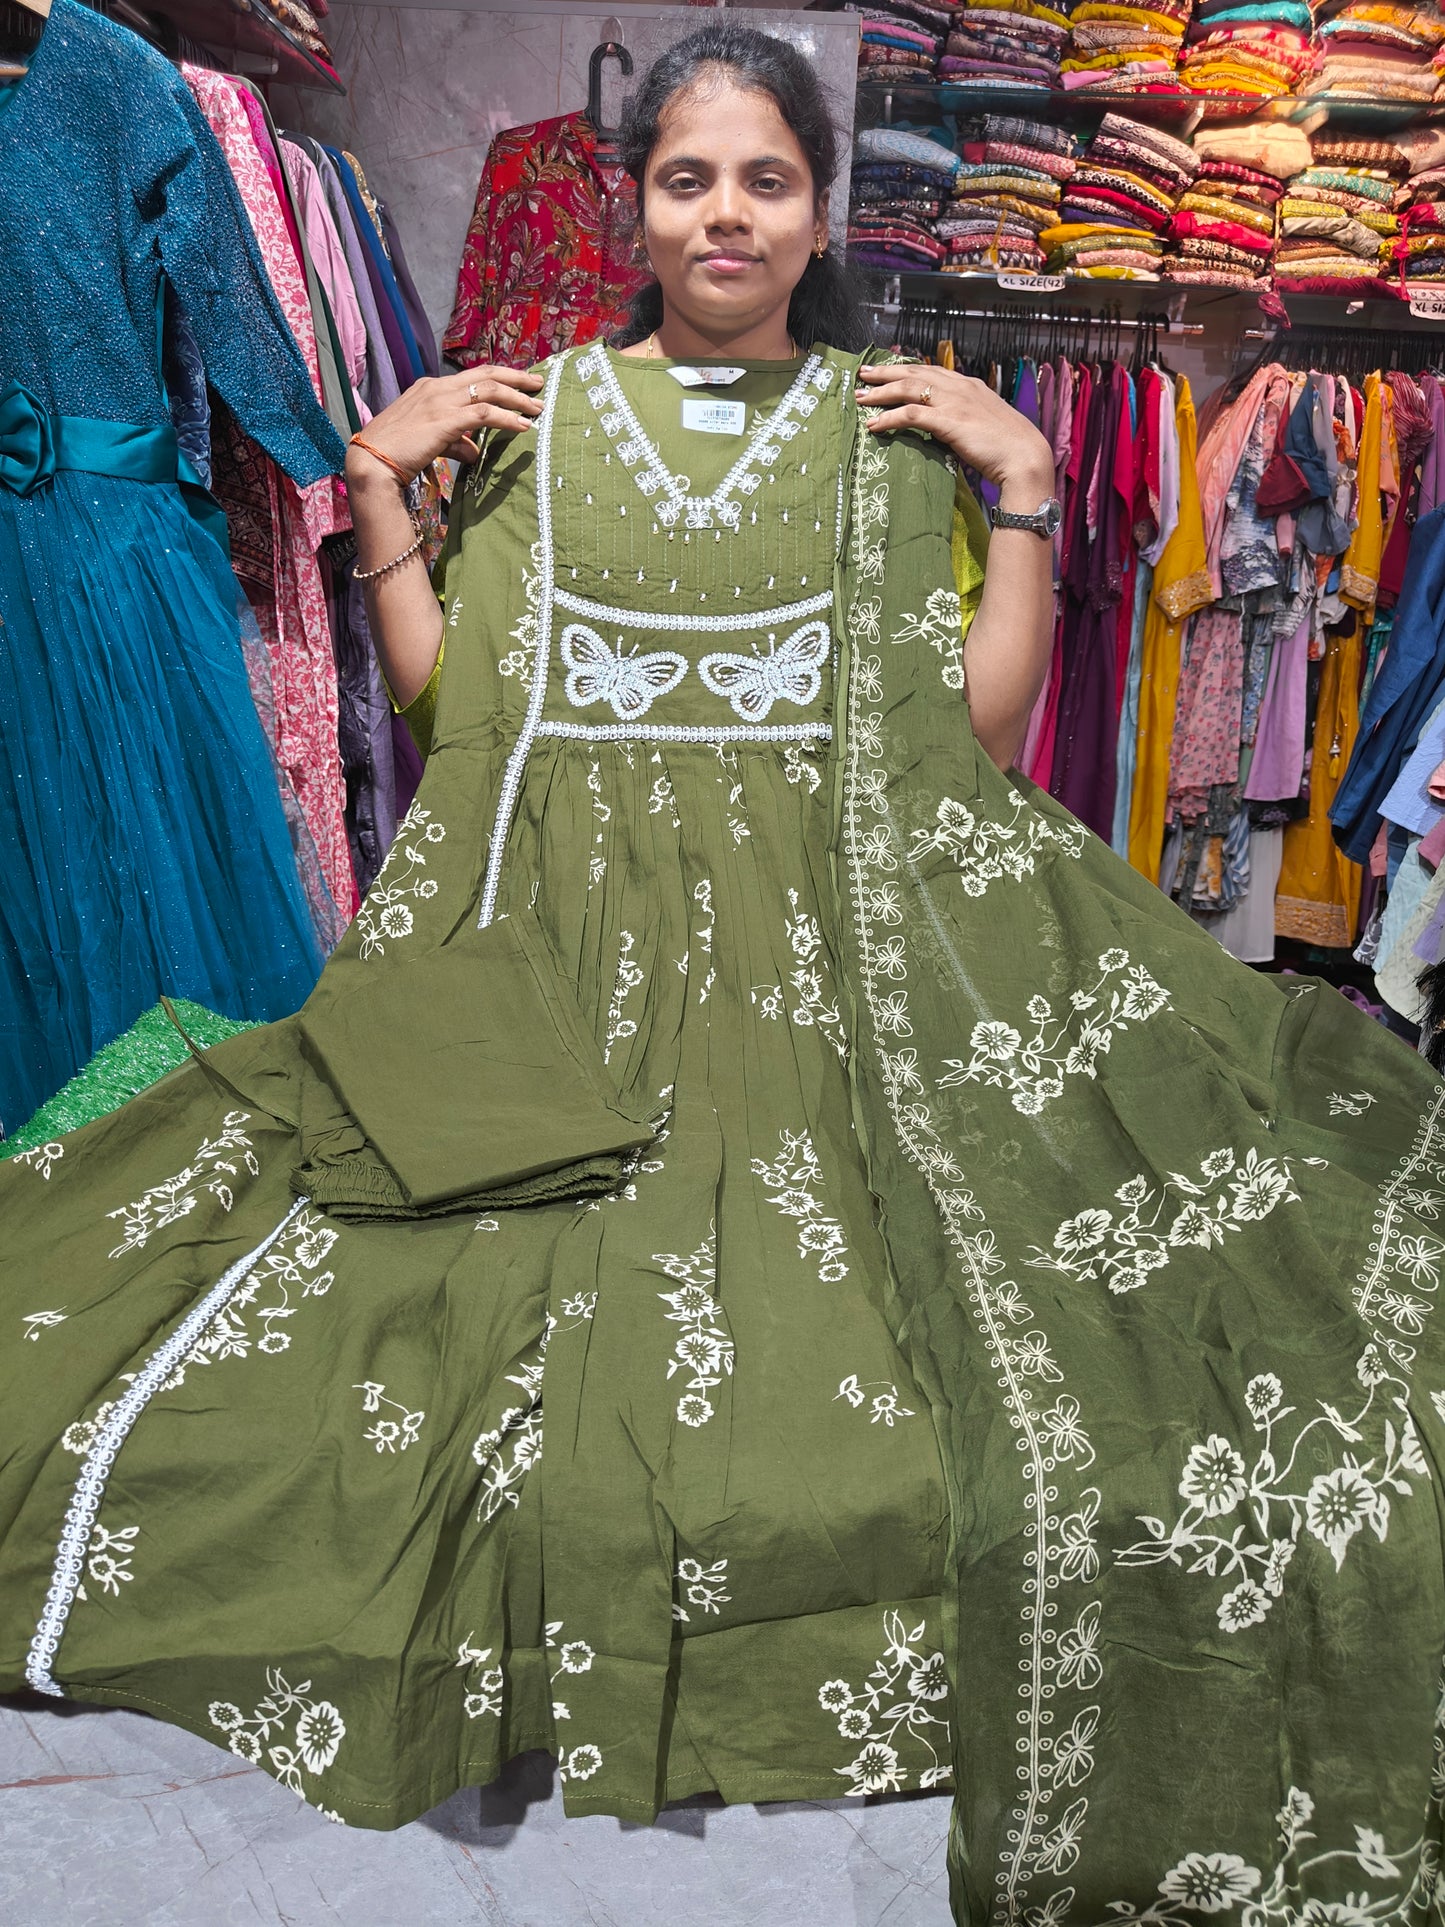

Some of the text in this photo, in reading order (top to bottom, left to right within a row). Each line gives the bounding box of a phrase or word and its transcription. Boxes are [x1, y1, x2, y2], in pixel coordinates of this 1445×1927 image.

[1003, 276, 1064, 289] XL SIZE(42)
[1415, 302, 1427, 313] XL
